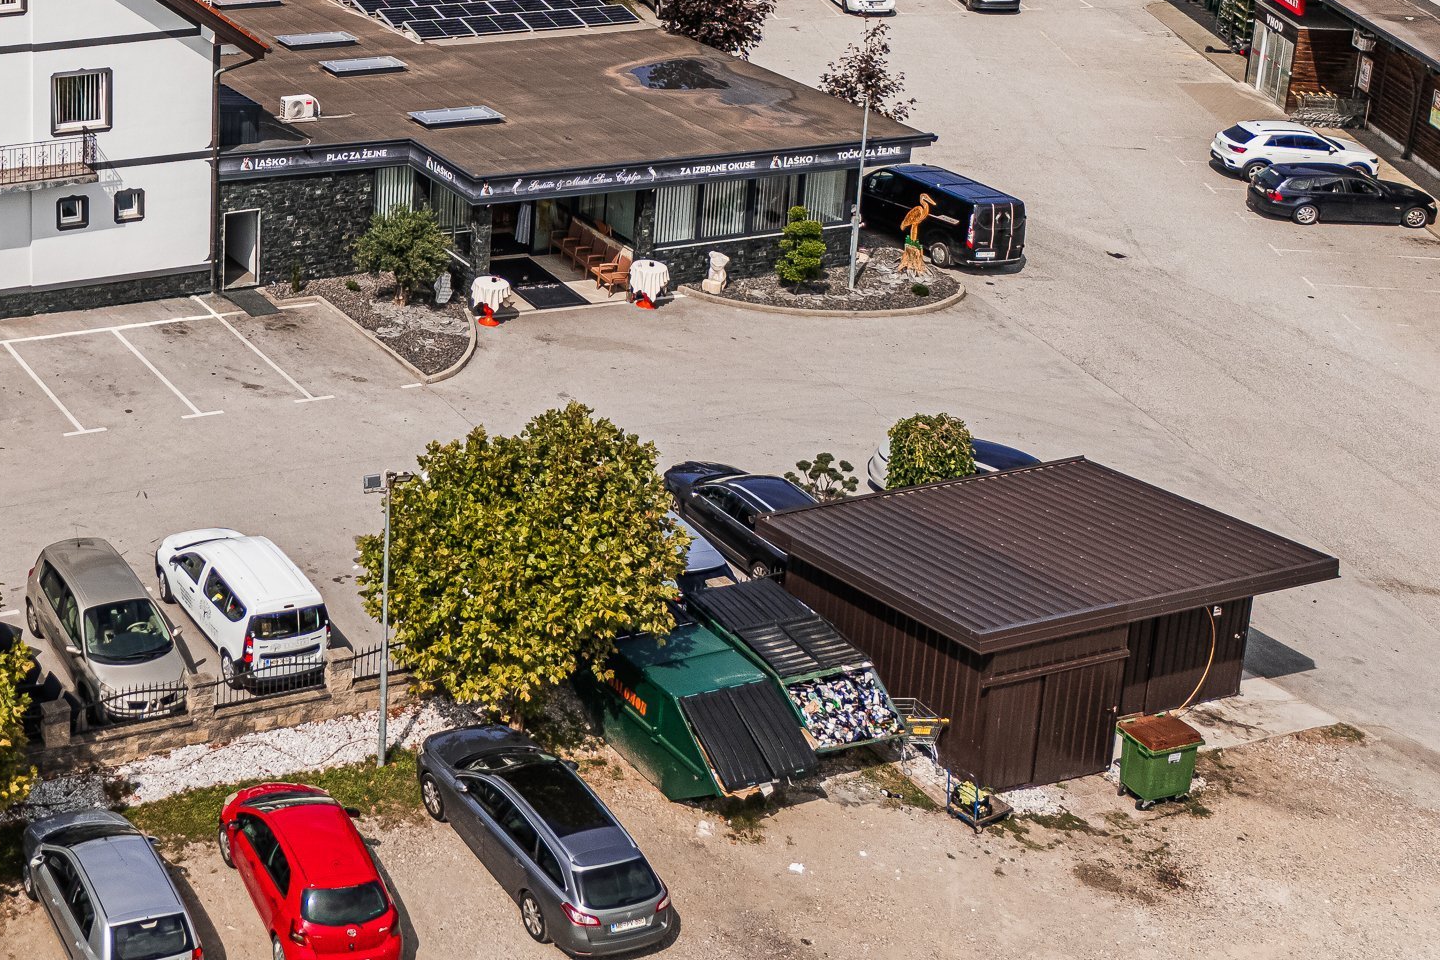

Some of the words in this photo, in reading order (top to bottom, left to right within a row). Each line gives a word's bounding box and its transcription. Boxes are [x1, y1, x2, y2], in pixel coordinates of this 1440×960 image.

[1266, 13, 1284, 32] VHOD
[327, 152, 348, 162] PLAC
[349, 151, 361, 160] ZA
[362, 148, 388, 159] ŽEJNE
[837, 148, 863, 160] TOČKA
[865, 148, 876, 157] ZA
[876, 146, 902, 156] ŽEJNE
[255, 157, 287, 170] LAŠKO
[680, 167, 692, 176] ZA
[692, 163, 727, 174] IZBRANE
[728, 160, 756, 171] OKUSE
[783, 155, 814, 168] LAŠKO
[434, 161, 453, 180] LAŠKO
[615, 168, 642, 185] Čaplja
